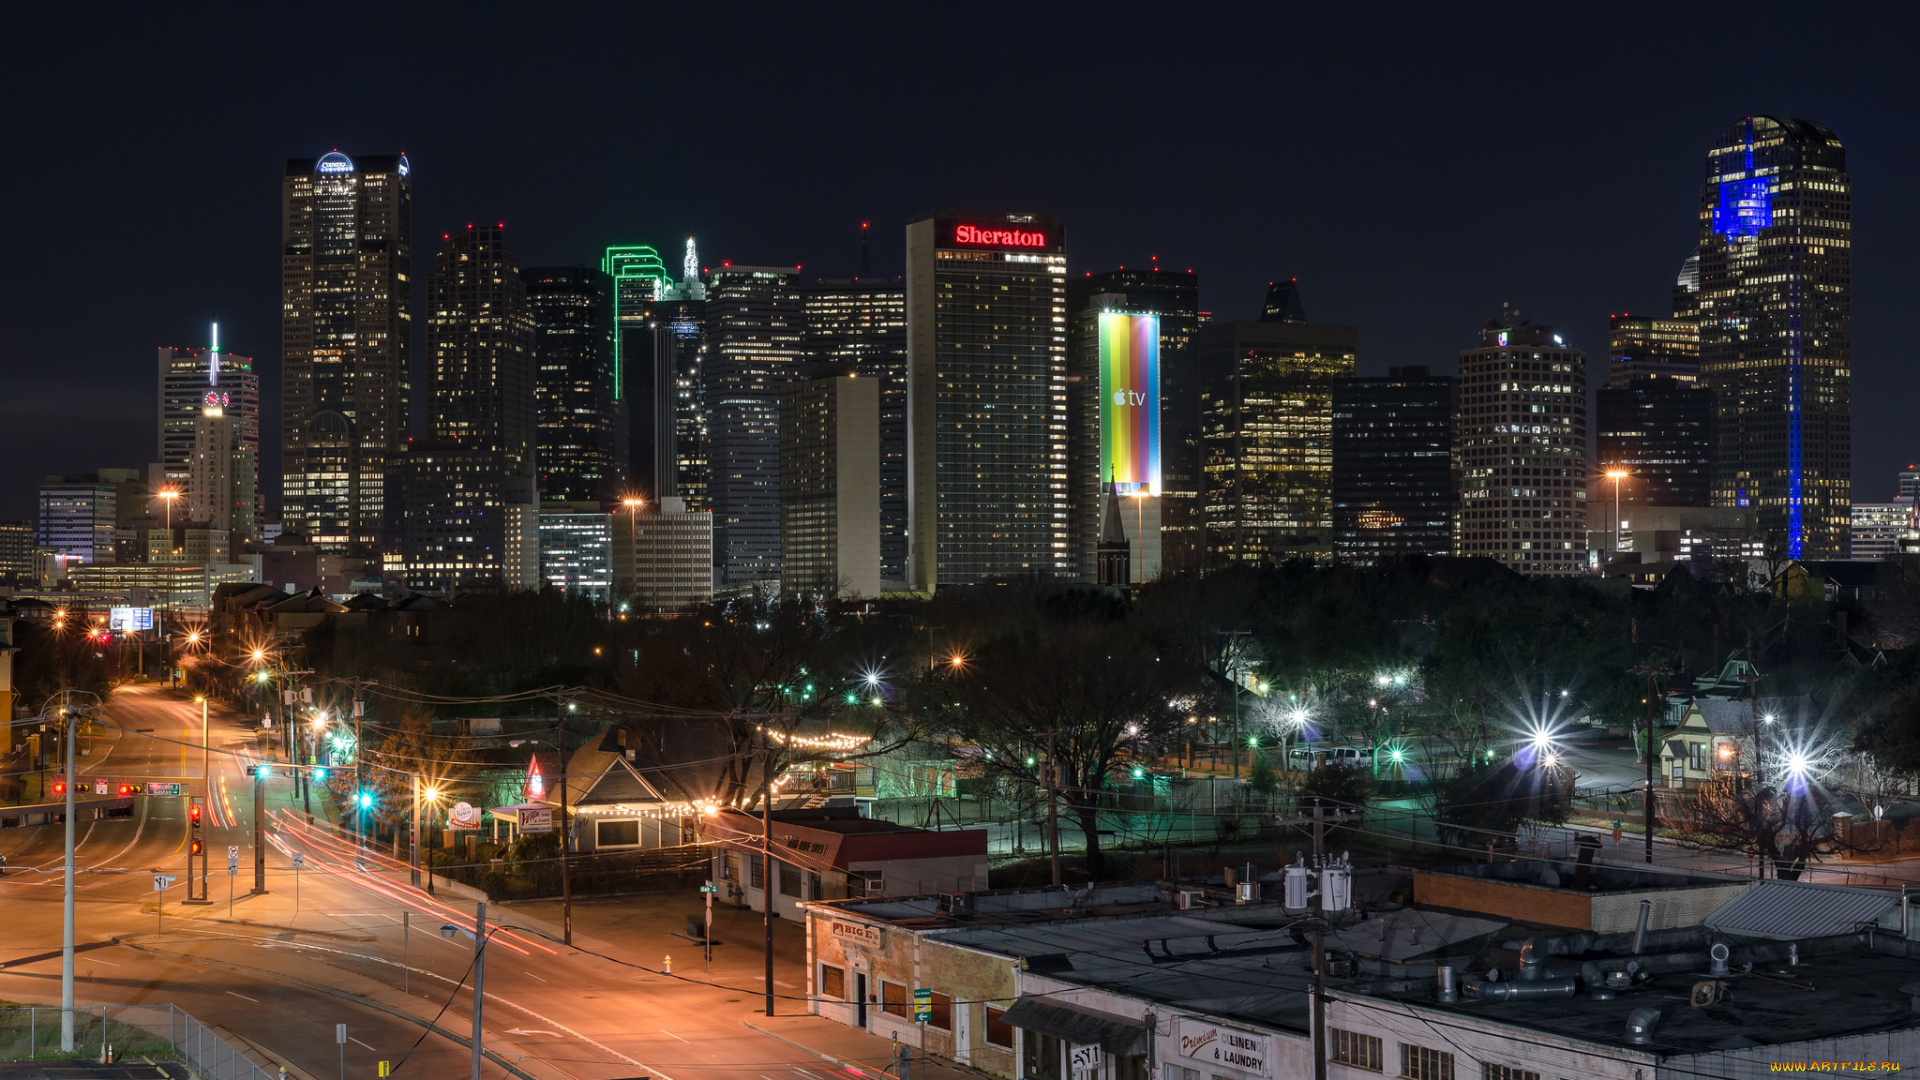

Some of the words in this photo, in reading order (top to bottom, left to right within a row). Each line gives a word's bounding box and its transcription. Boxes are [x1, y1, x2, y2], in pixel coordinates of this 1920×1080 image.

[956, 225, 1045, 247] Sheraton
[1127, 389, 1145, 406] tv
[844, 924, 864, 937] BIG
[1181, 1028, 1218, 1054] Premium
[1214, 1047, 1221, 1060] &
[1224, 1049, 1263, 1072] LAUNDRY
